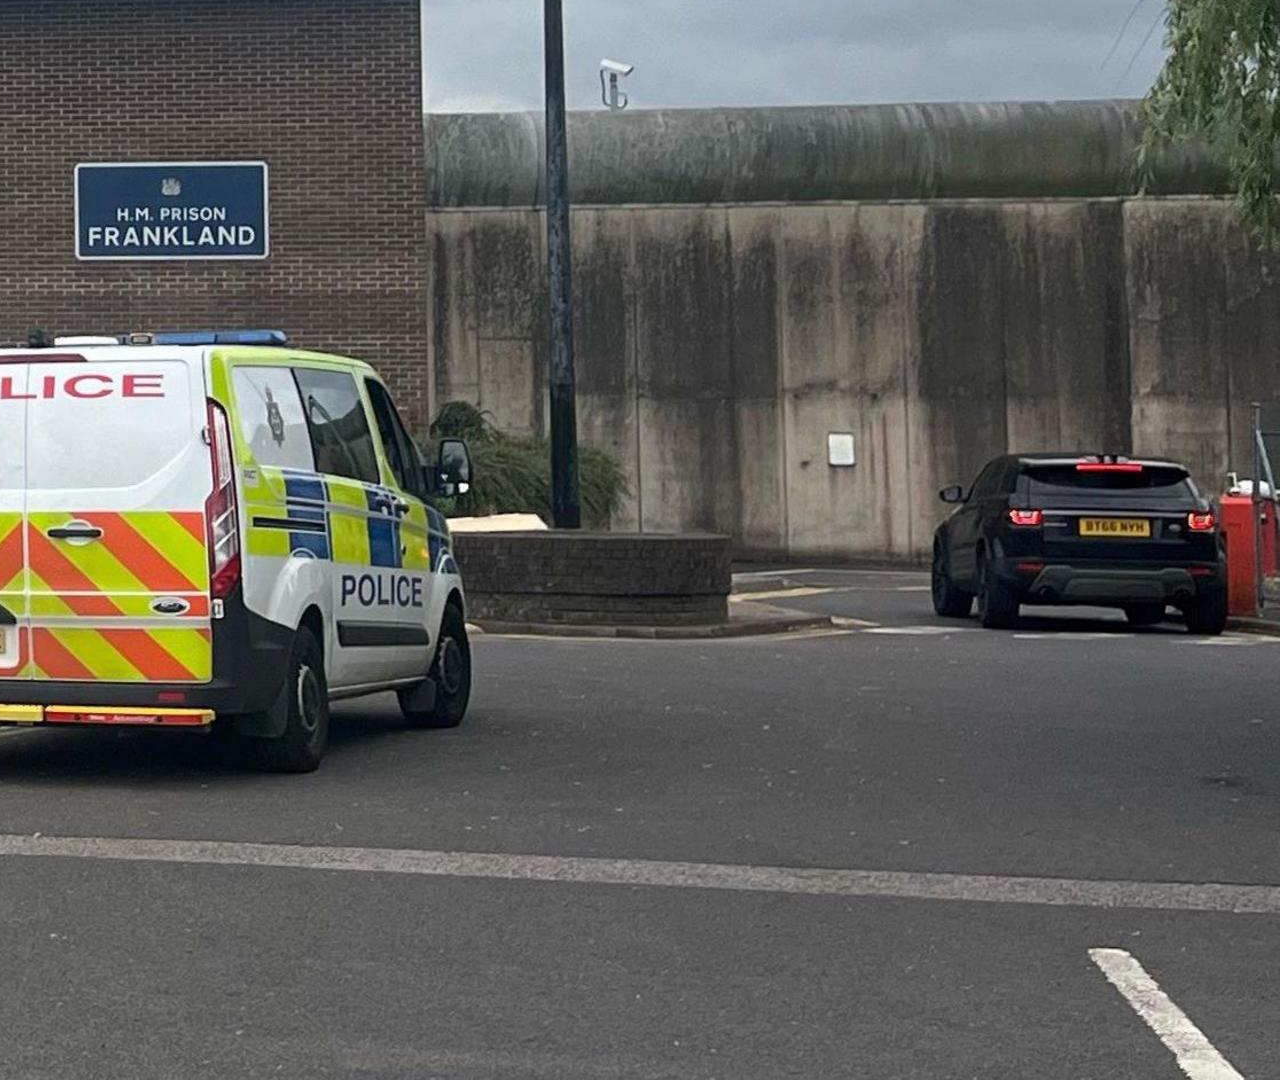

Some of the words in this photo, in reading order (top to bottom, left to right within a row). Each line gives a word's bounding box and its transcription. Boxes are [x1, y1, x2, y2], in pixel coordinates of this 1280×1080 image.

[117, 207, 154, 221] H.M.
[160, 207, 226, 221] PRISON
[89, 226, 255, 246] FRANKLAND
[341, 573, 423, 607] POLICE
